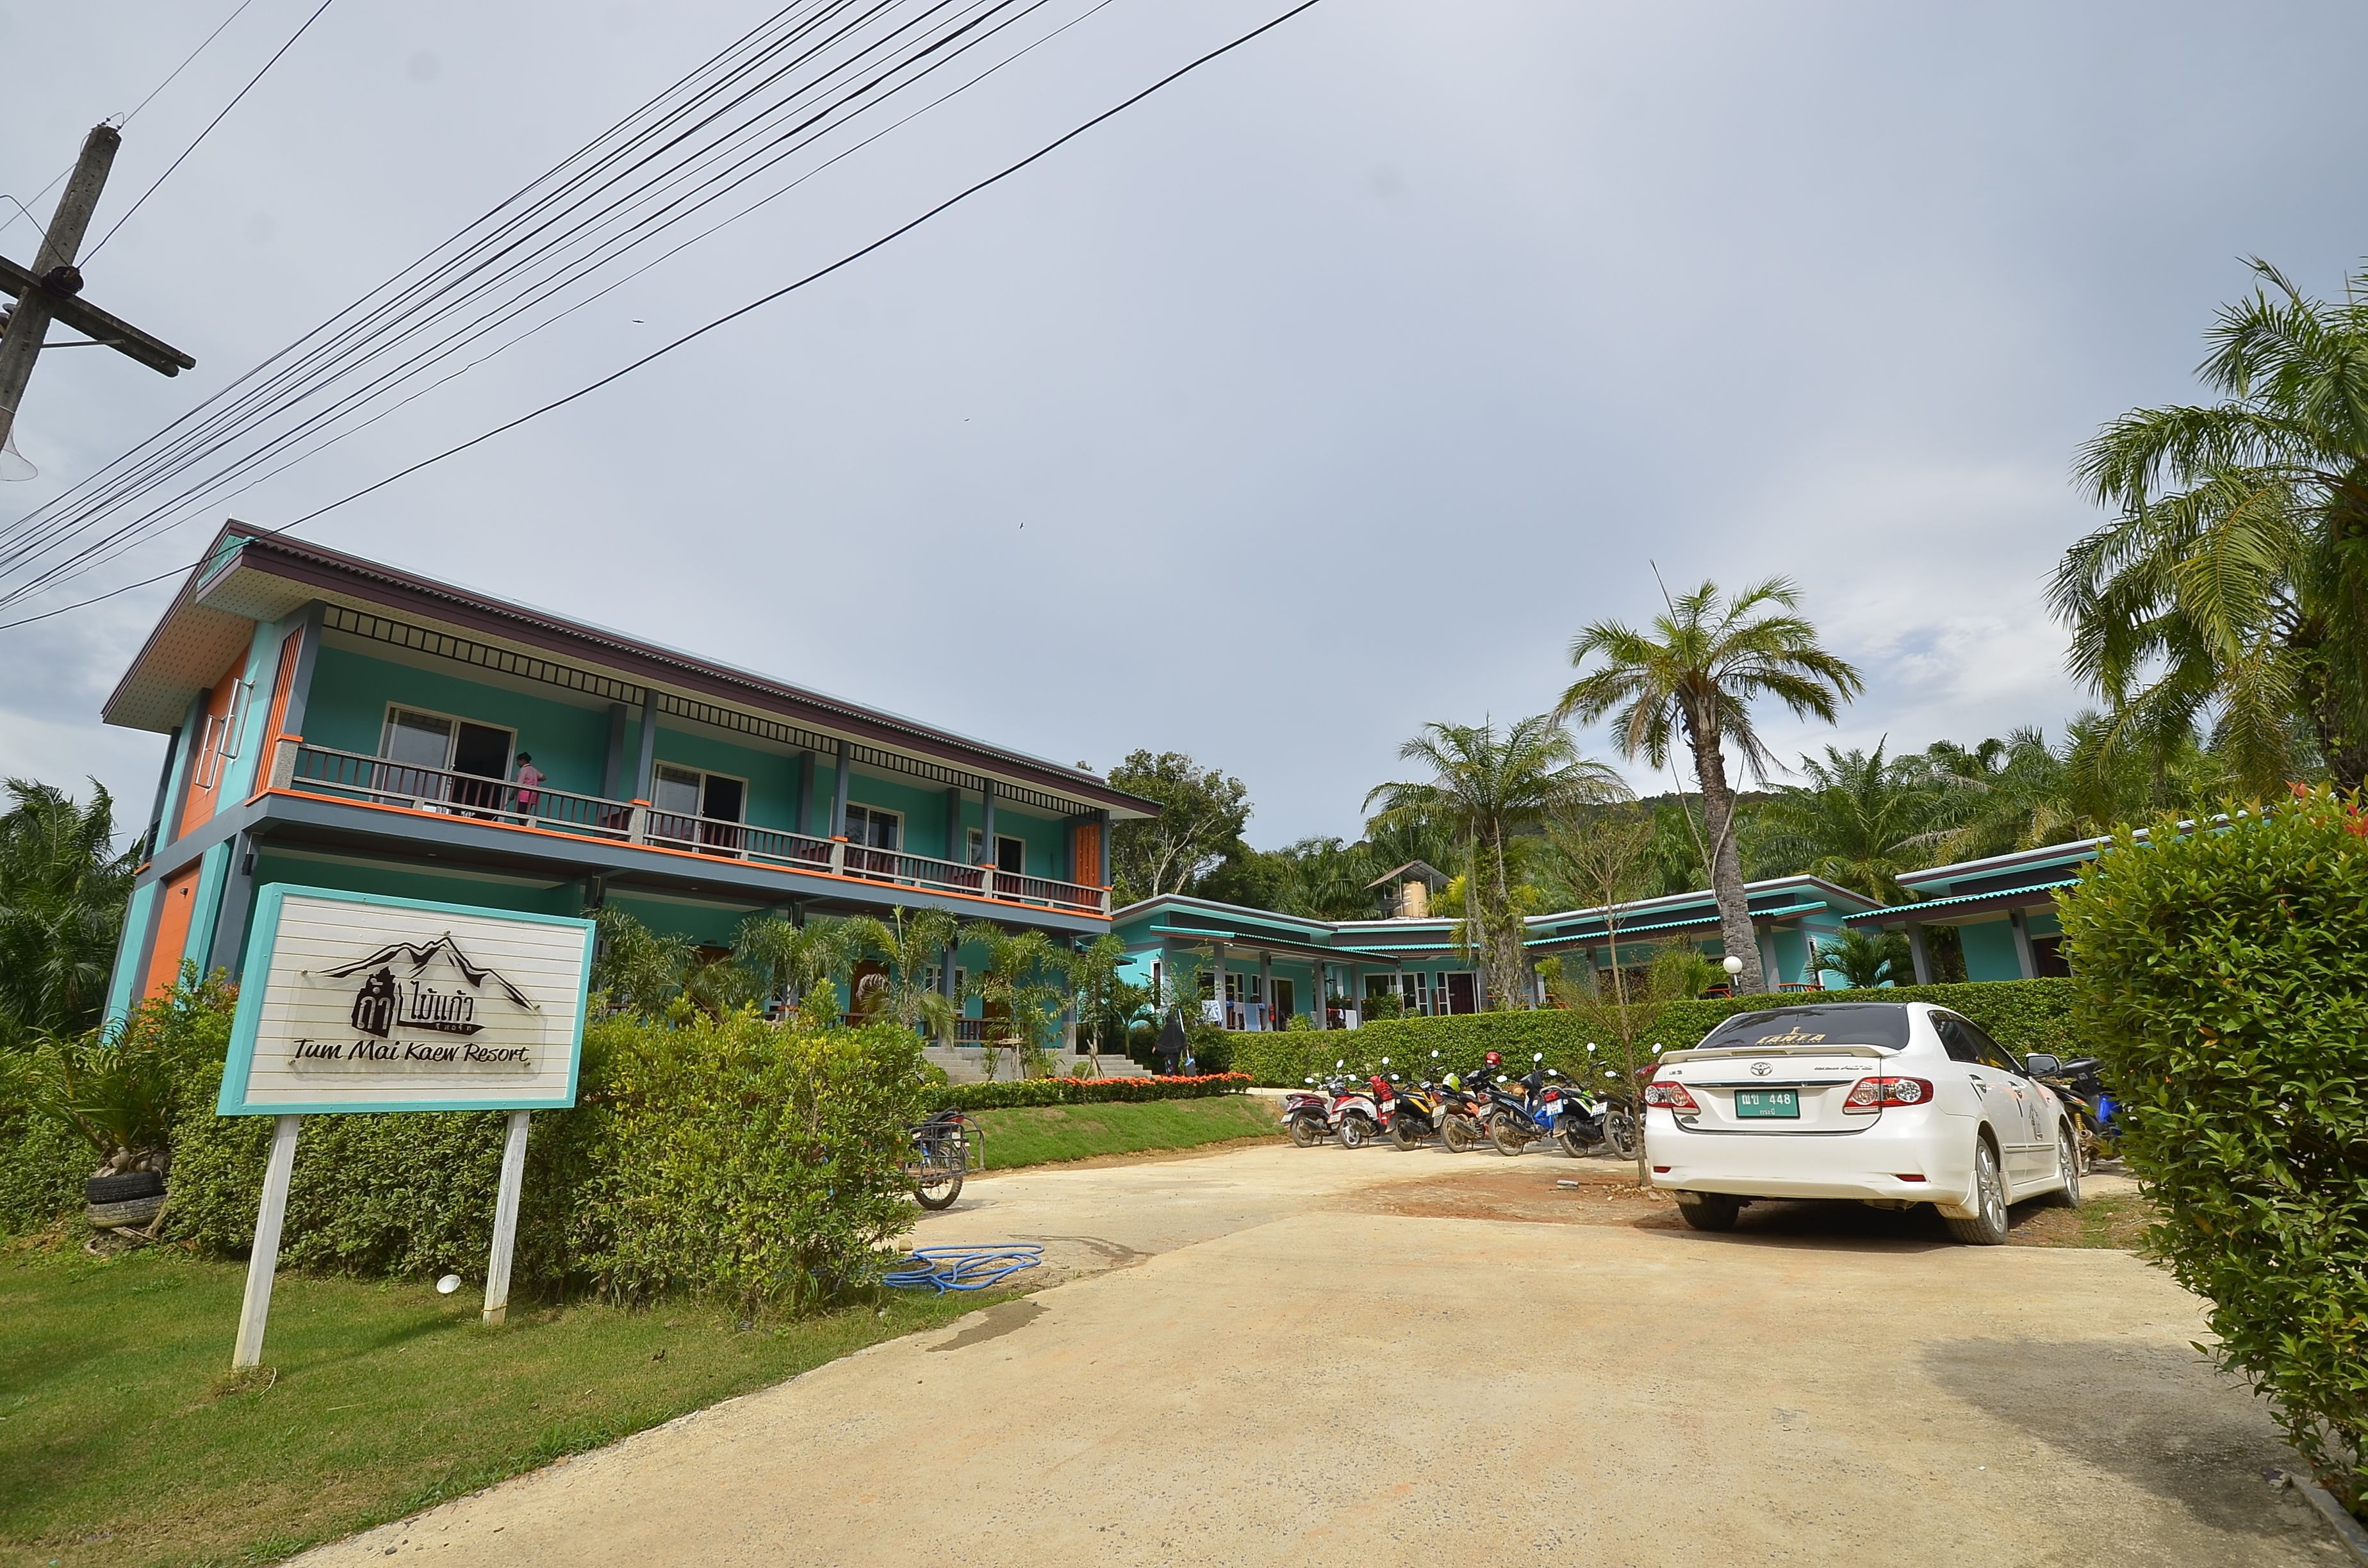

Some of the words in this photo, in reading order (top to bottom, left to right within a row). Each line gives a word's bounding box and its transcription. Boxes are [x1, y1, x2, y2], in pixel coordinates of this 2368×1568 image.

[357, 977, 391, 1029] ถ้ำ
[410, 981, 474, 1022] ไม้แก้ว
[293, 1038, 343, 1059] Tum
[348, 1040, 400, 1061] Mai
[404, 1042, 461, 1063] Kaew
[463, 1043, 530, 1063] Resort
[1769, 1093, 1791, 1105] 448
